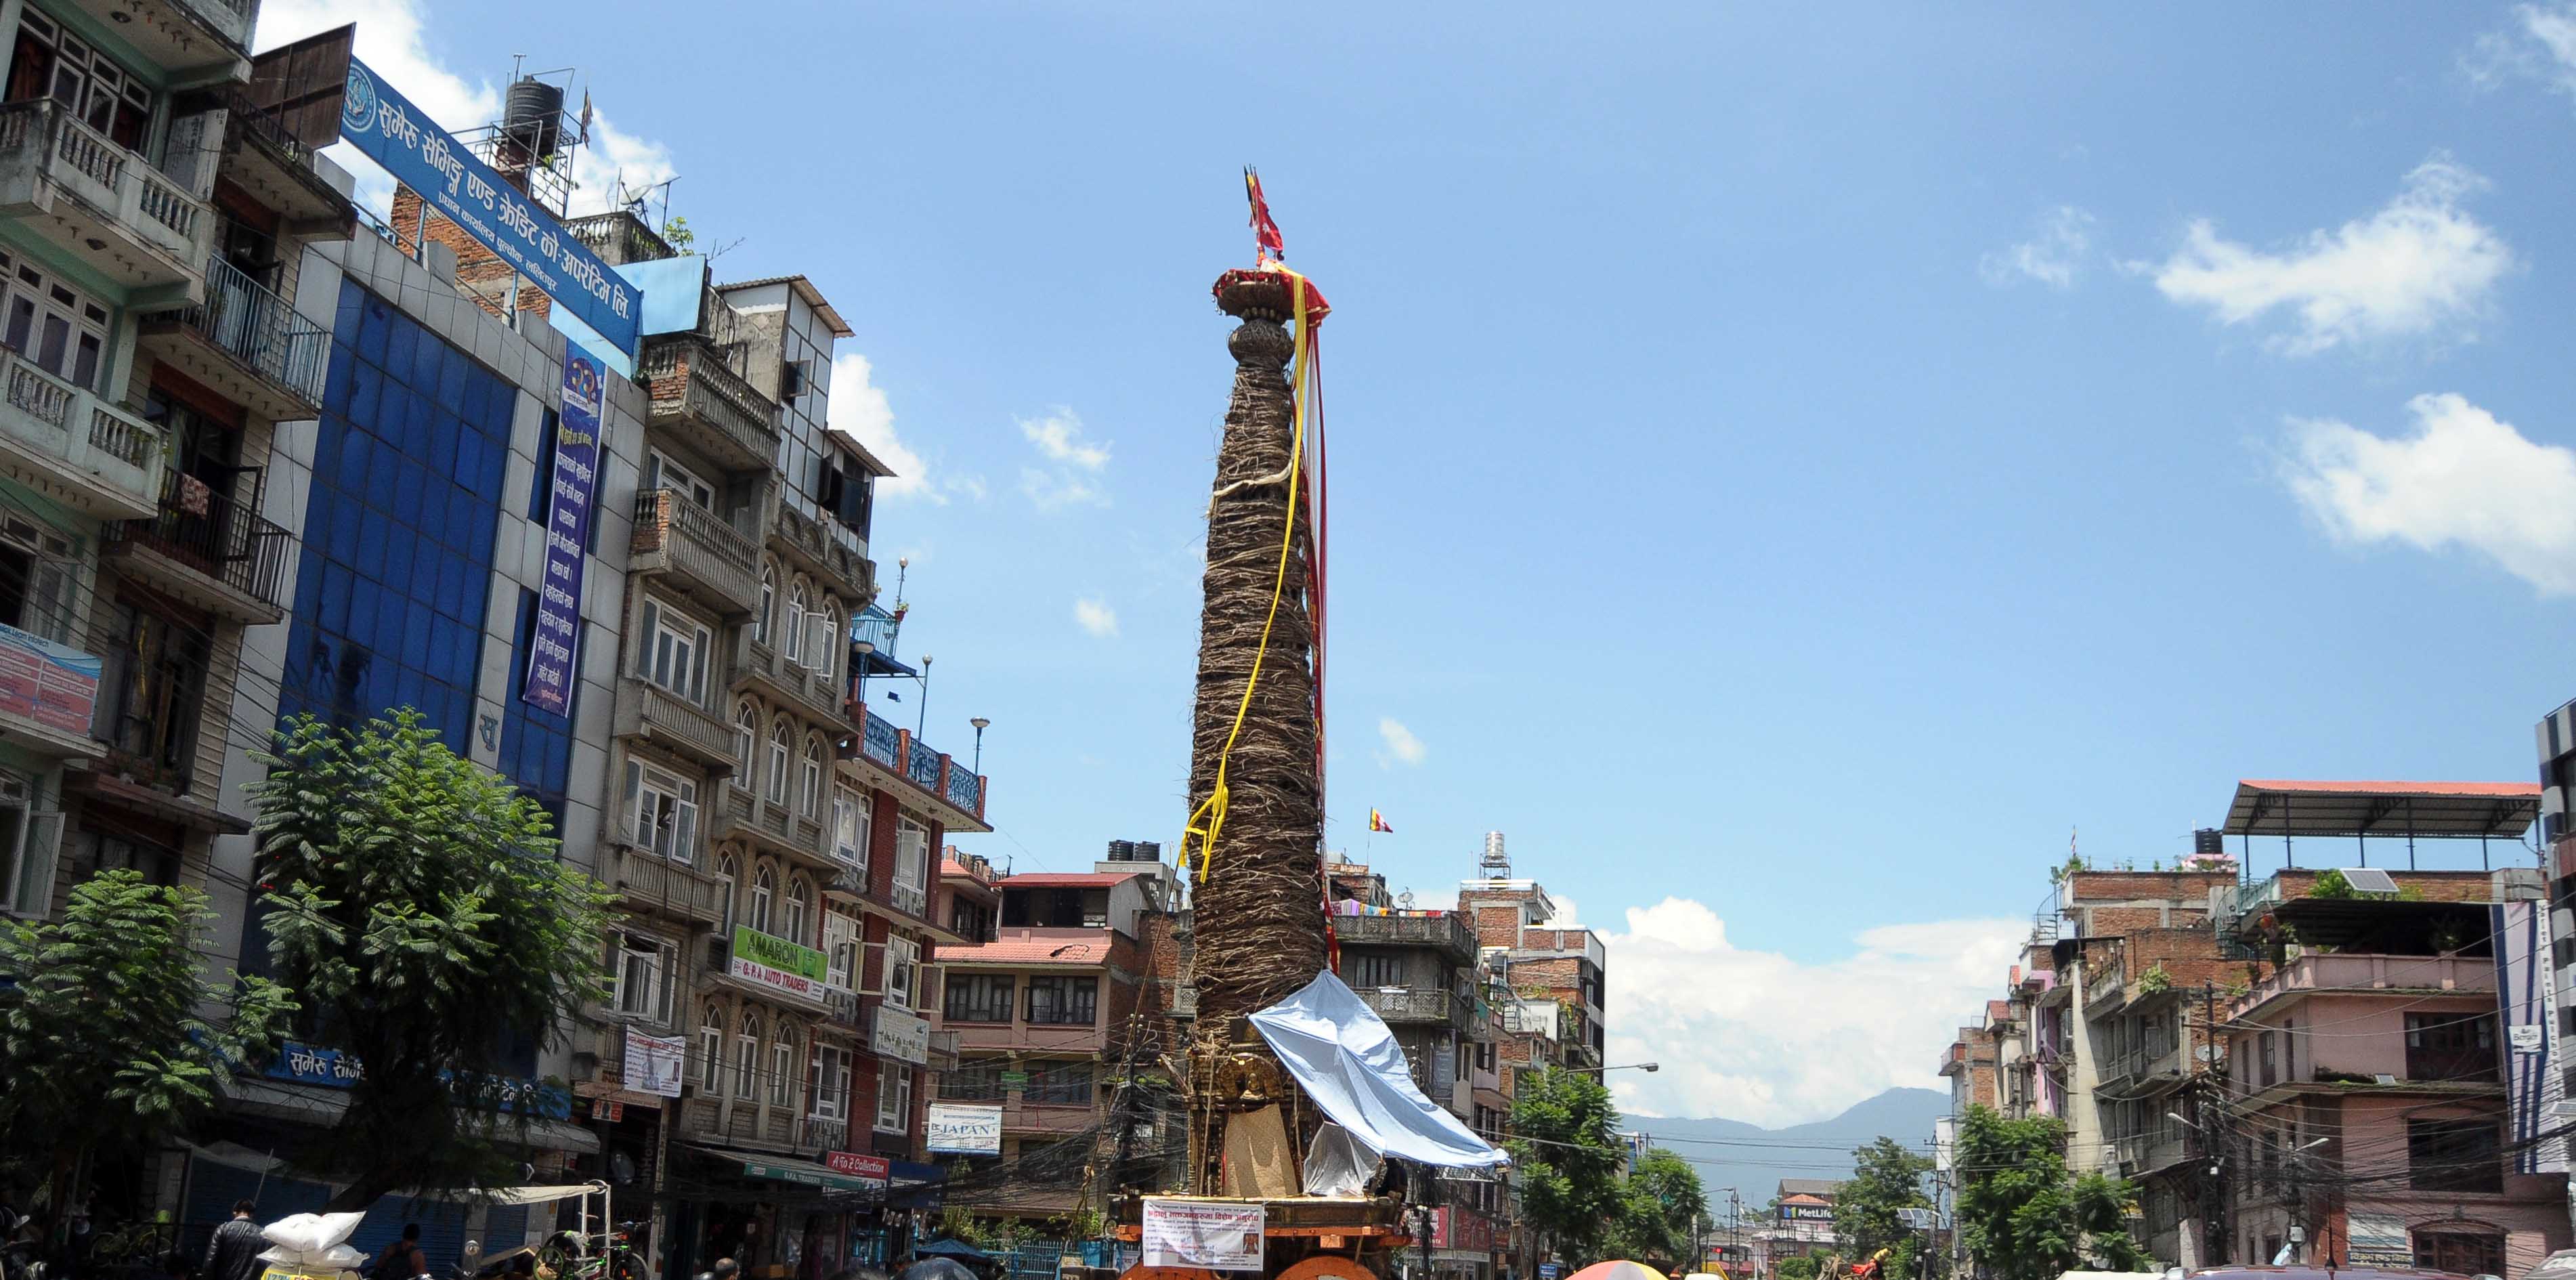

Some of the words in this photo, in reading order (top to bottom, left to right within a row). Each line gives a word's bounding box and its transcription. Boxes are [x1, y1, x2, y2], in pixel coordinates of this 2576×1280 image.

[497, 192, 540, 247] क्रेडिट
[747, 933, 798, 966] AMARON
[764, 969, 781, 985] AUTO
[782, 974, 809, 993] TRADERS
[832, 1155, 840, 1168] A
[855, 1159, 884, 1174] Collection
